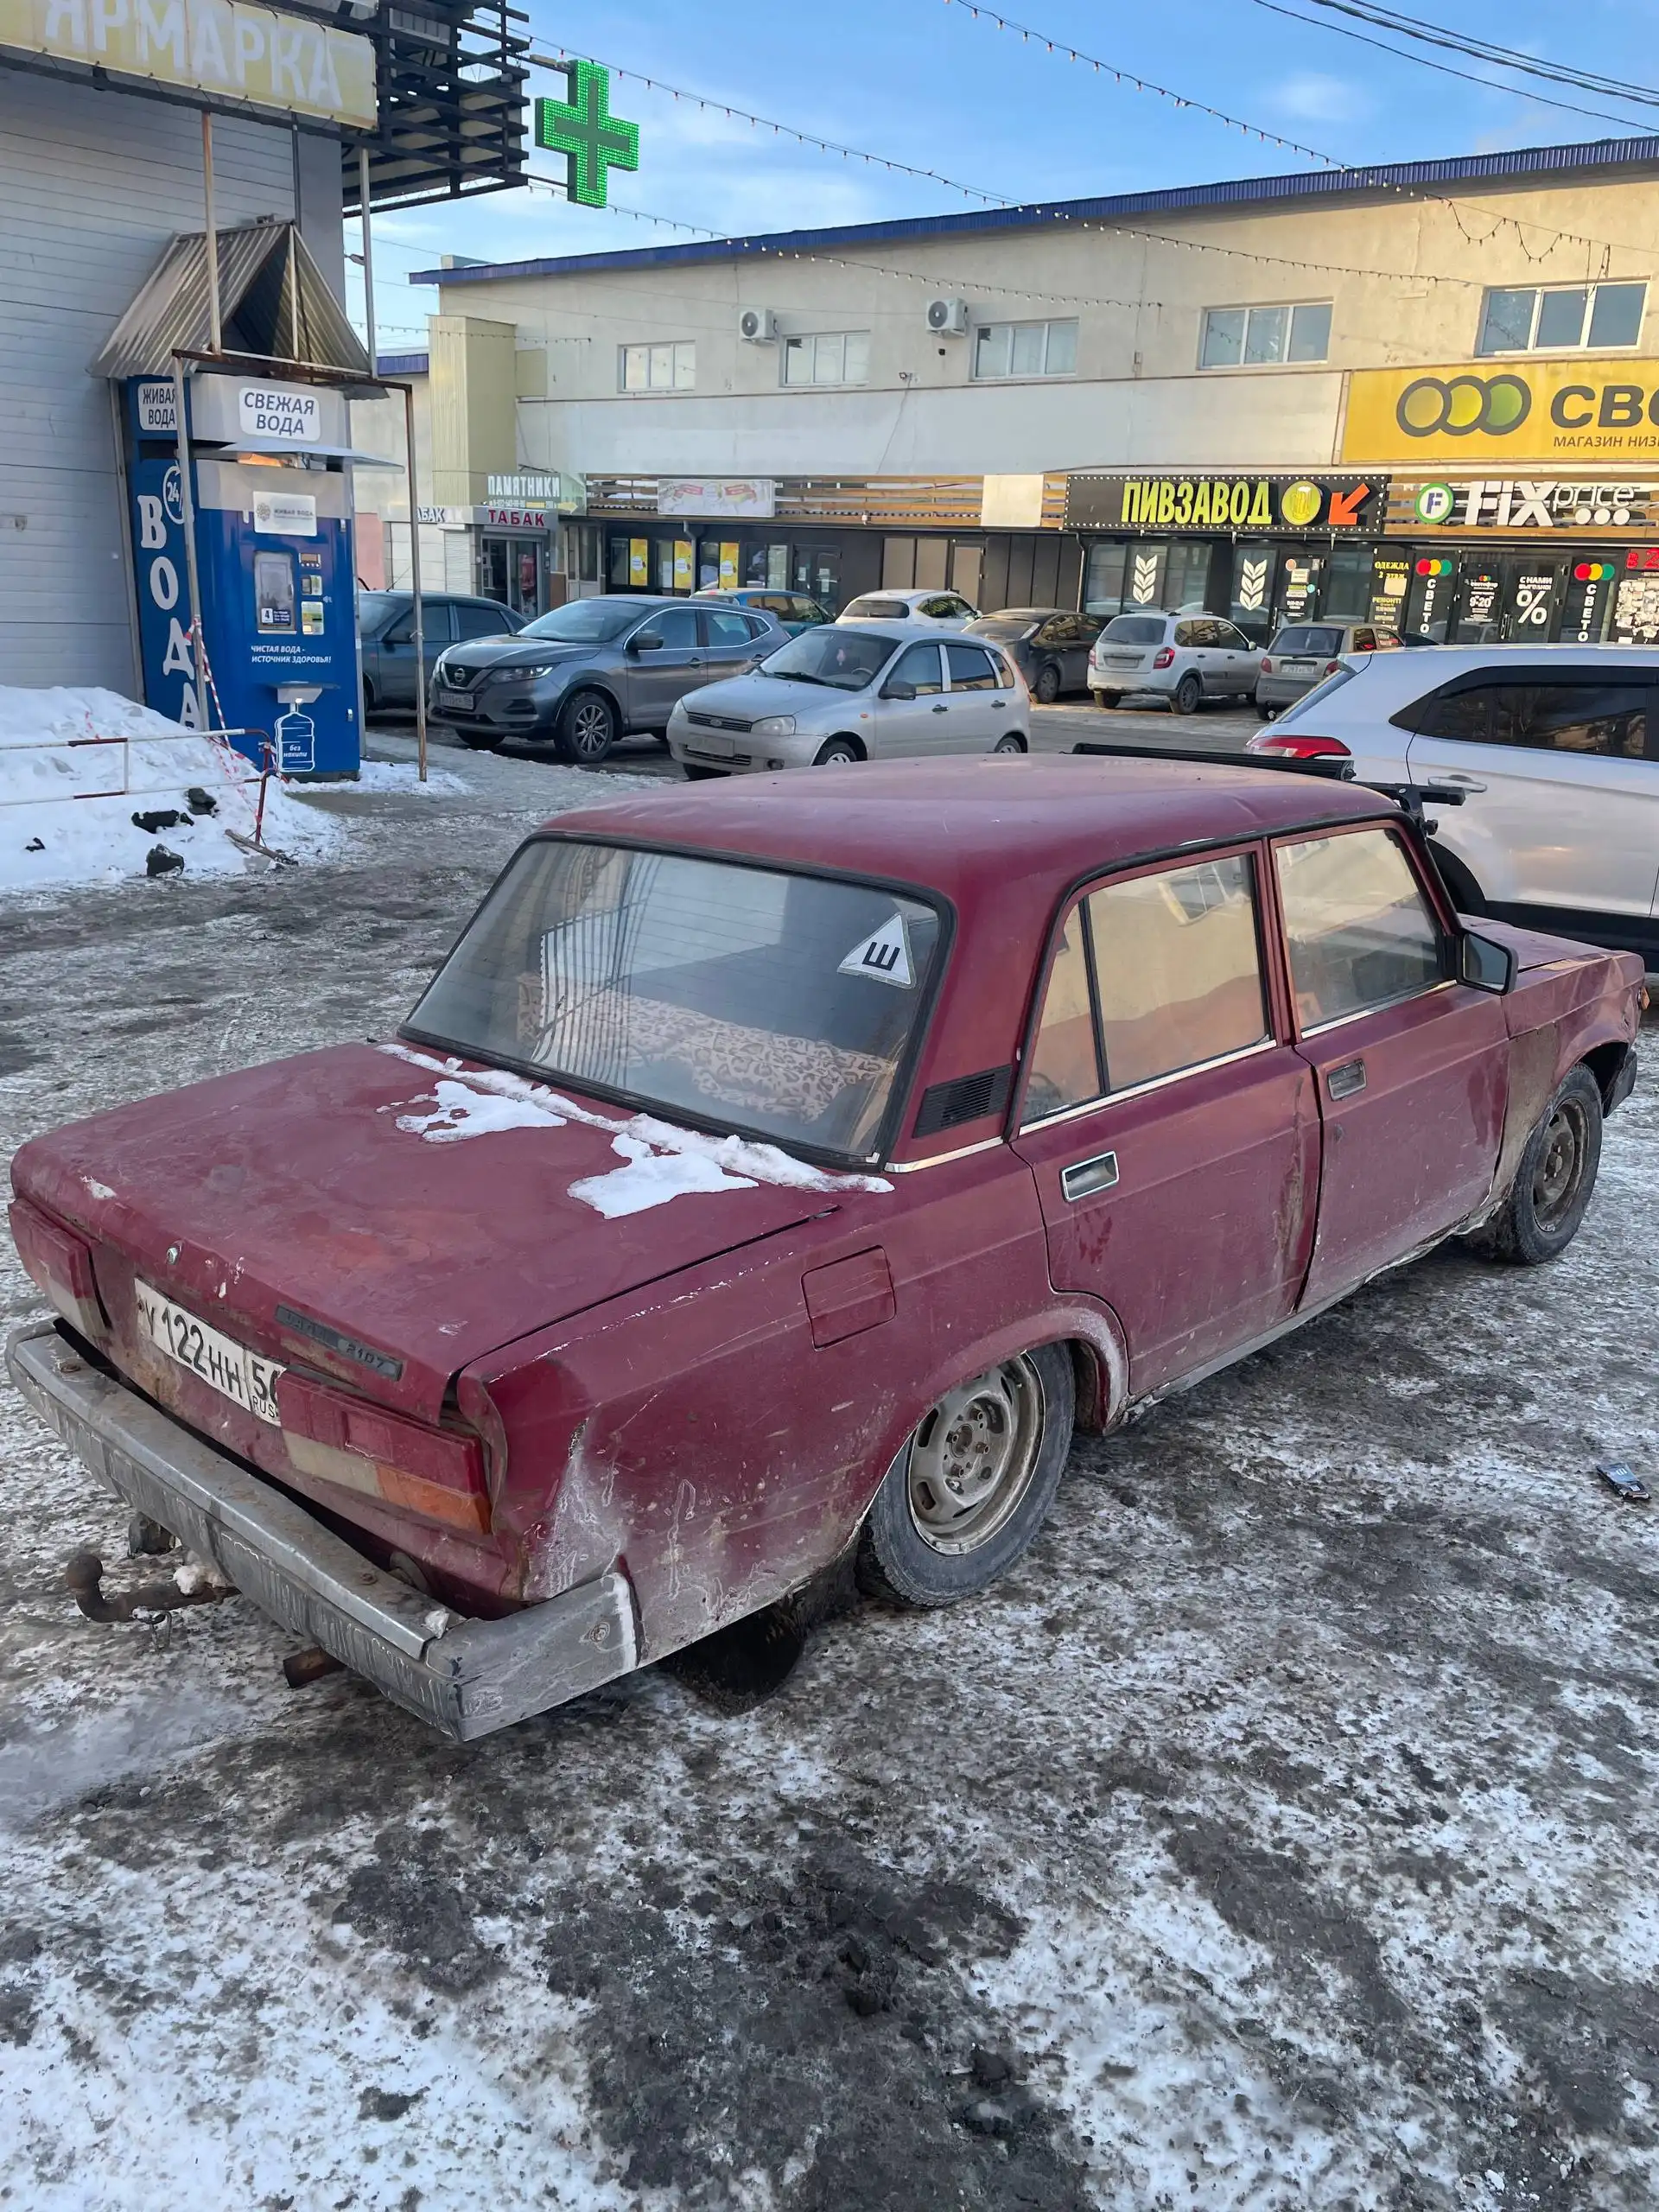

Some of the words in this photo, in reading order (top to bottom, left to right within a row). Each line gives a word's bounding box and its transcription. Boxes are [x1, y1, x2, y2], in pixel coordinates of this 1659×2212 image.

[45, 0, 344, 109] ЯРМАРКА
[244, 391, 315, 416] СВЕЖАЯ
[1551, 385, 1659, 429] СВ
[149, 409, 175, 428] ВОДА
[257, 414, 305, 436] ВОДА
[1553, 436, 1624, 448] МАГАЗИН
[1628, 435, 1659, 448] НИЗ
[166, 481, 180, 501] 24
[487, 475, 561, 498] ПАМЯТНИКИ
[1121, 480, 1273, 524] ПИВЗАВОД
[1554, 485, 1636, 512] price
[488, 509, 544, 527] ТАБАК
[1374, 561, 1410, 570] ОДЕЖДА
[1420, 578, 1437, 633] СВЕТО
[1578, 584, 1597, 642] СВЕТО
[251, 655, 291, 664] ИСТОЧНИК
[280, 645, 302, 654] ВОДА
[346, 1344, 385, 1369] 2107
[251, 1395, 276, 1419] RUS
